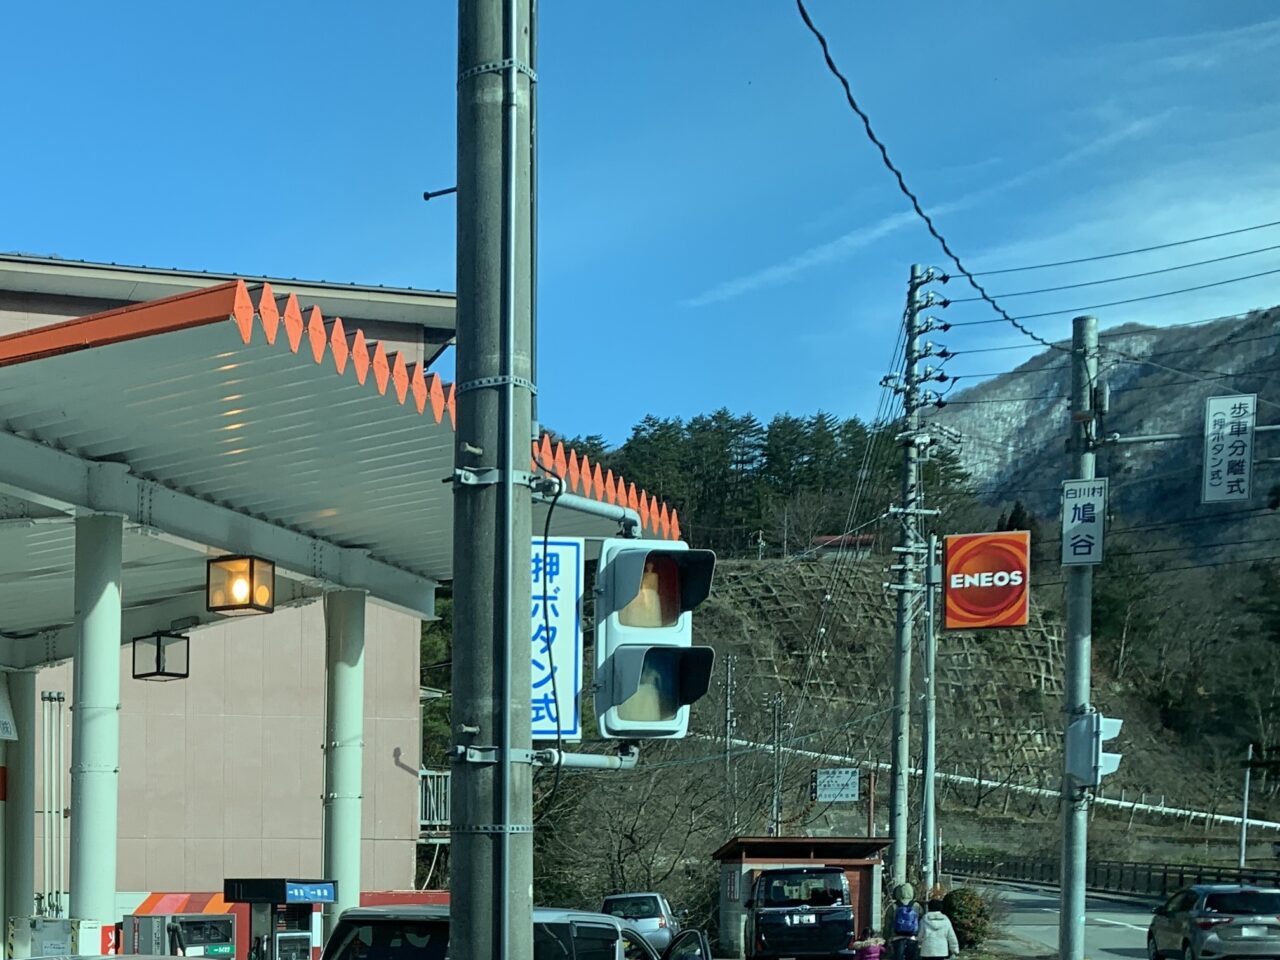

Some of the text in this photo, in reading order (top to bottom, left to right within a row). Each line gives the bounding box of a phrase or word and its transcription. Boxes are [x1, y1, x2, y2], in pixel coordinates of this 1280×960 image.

[1226, 402, 1249, 495] 歩車分離式
[1065, 486, 1103, 499] 白川村
[1070, 502, 1096, 556] 鳩谷
[950, 570, 1023, 588] ENEOS
[531, 552, 560, 723] 押ボタン式
